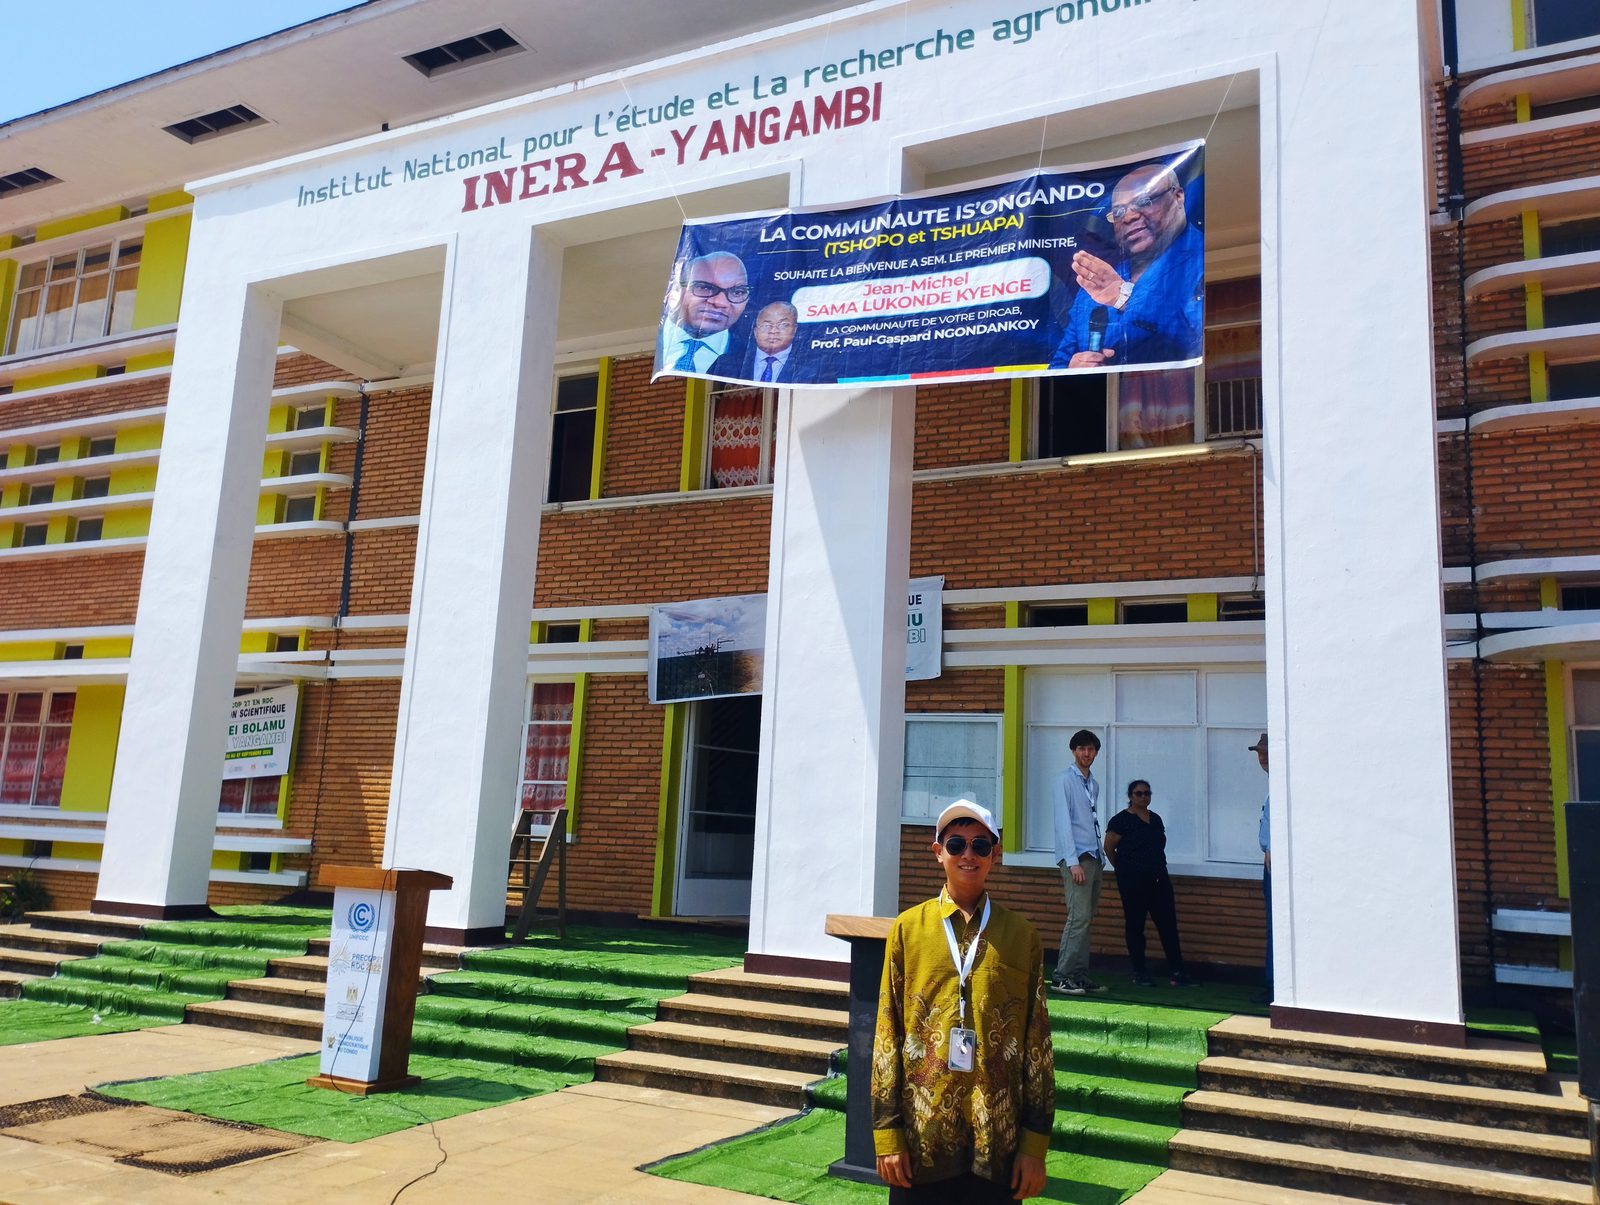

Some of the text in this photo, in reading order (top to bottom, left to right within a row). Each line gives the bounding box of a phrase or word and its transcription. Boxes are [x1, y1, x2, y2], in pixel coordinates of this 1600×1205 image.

[297, 166, 392, 207] Institut
[403, 137, 512, 182] National
[523, 125, 582, 161] pour
[708, 83, 739, 109] et
[804, 29, 975, 88] recherche
[760, 226, 786, 242] LA
[791, 207, 949, 241] COMMUNAUTE
[824, 213, 1024, 258] (TSHOPO et TSHUAPA)
[774, 236, 1077, 281] SOUHAITE LA BIENVENUE A SEM. LE PREMIER MINISTRE,
[806, 279, 1032, 317] SAMA LUKONDE KYENGE
[863, 272, 969, 297] Jean-Michel
[811, 319, 1039, 350] Prof. Paul-Gaspard NGONDANKOY
[825, 306, 1023, 335] LA COMMUNAUTE DE VOTRE DIRCAB,
[239, 703, 286, 718] SCIENTIFIQUE
[232, 731, 286, 749] YANGAMBI
[242, 719, 286, 734] BOLAMU
